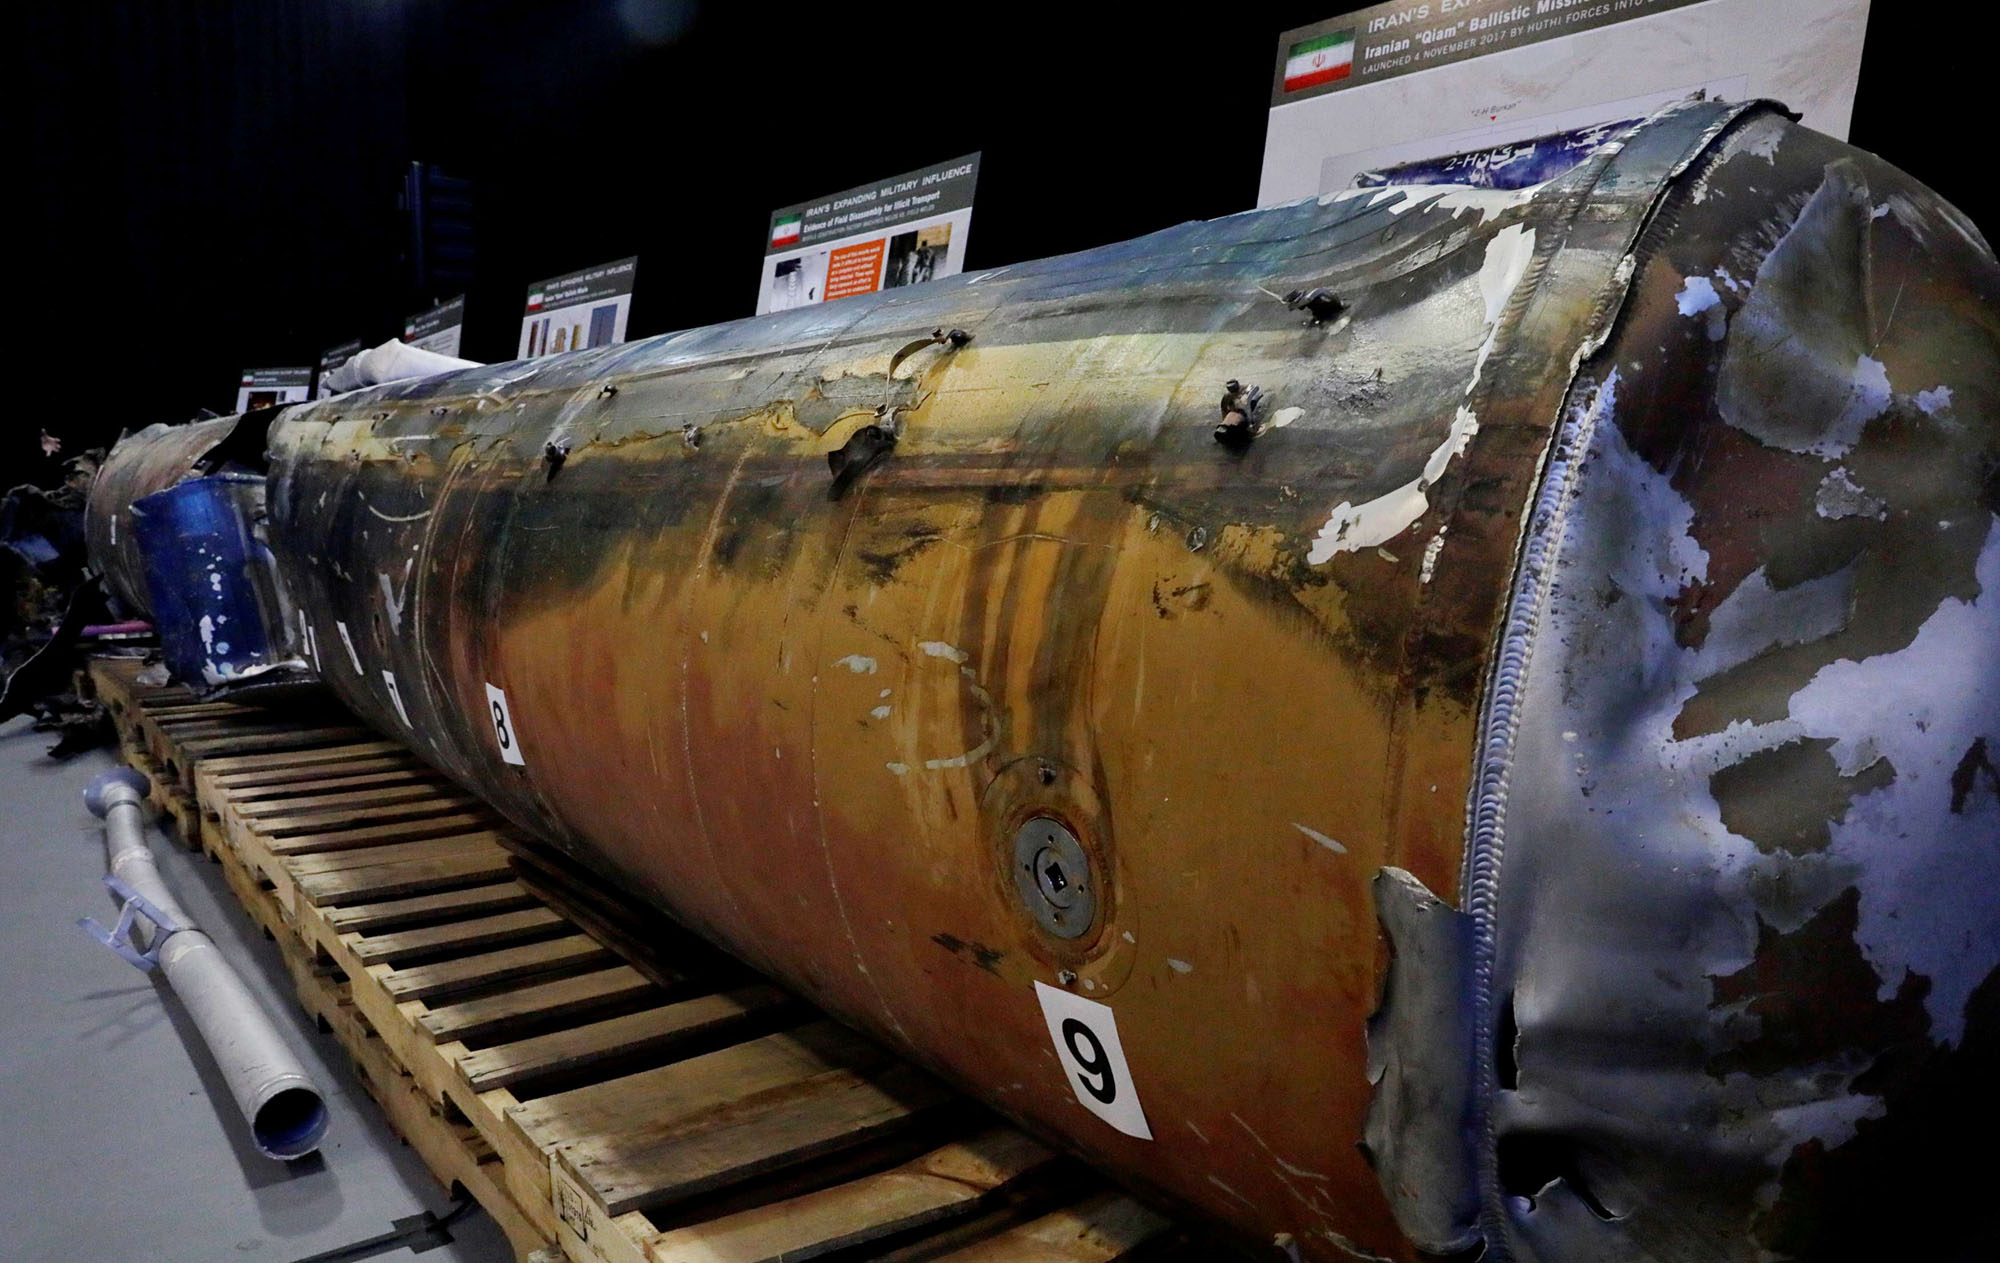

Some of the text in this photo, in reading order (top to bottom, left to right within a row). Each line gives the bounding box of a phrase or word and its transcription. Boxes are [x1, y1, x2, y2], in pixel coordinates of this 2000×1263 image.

[1362, 55, 1411, 75] LAUNCHED
[1414, 52, 1420, 61] 4
[1423, 38, 1476, 60] NOVEMBER
[1480, 30, 1506, 45] 2017
[1510, 26, 1524, 38] BY
[1527, 16, 1562, 33] HUTHI
[1565, 4, 1610, 24] FORCES
[1364, 38, 1410, 60] Iranian
[1415, 21, 1465, 45] "Qiam"
[1469, 6, 1531, 32] Ballistic
[1368, 5, 1430, 33] IRAN'S
[806, 163, 973, 218] IRAN'S EXPANDING MILITARY INFLUENCE
[803, 220, 827, 233] Evidence
[827, 217, 835, 228] of
[835, 213, 849, 227] Field
[493, 700, 510, 750] 8
[1062, 1018, 1116, 1104] 9
